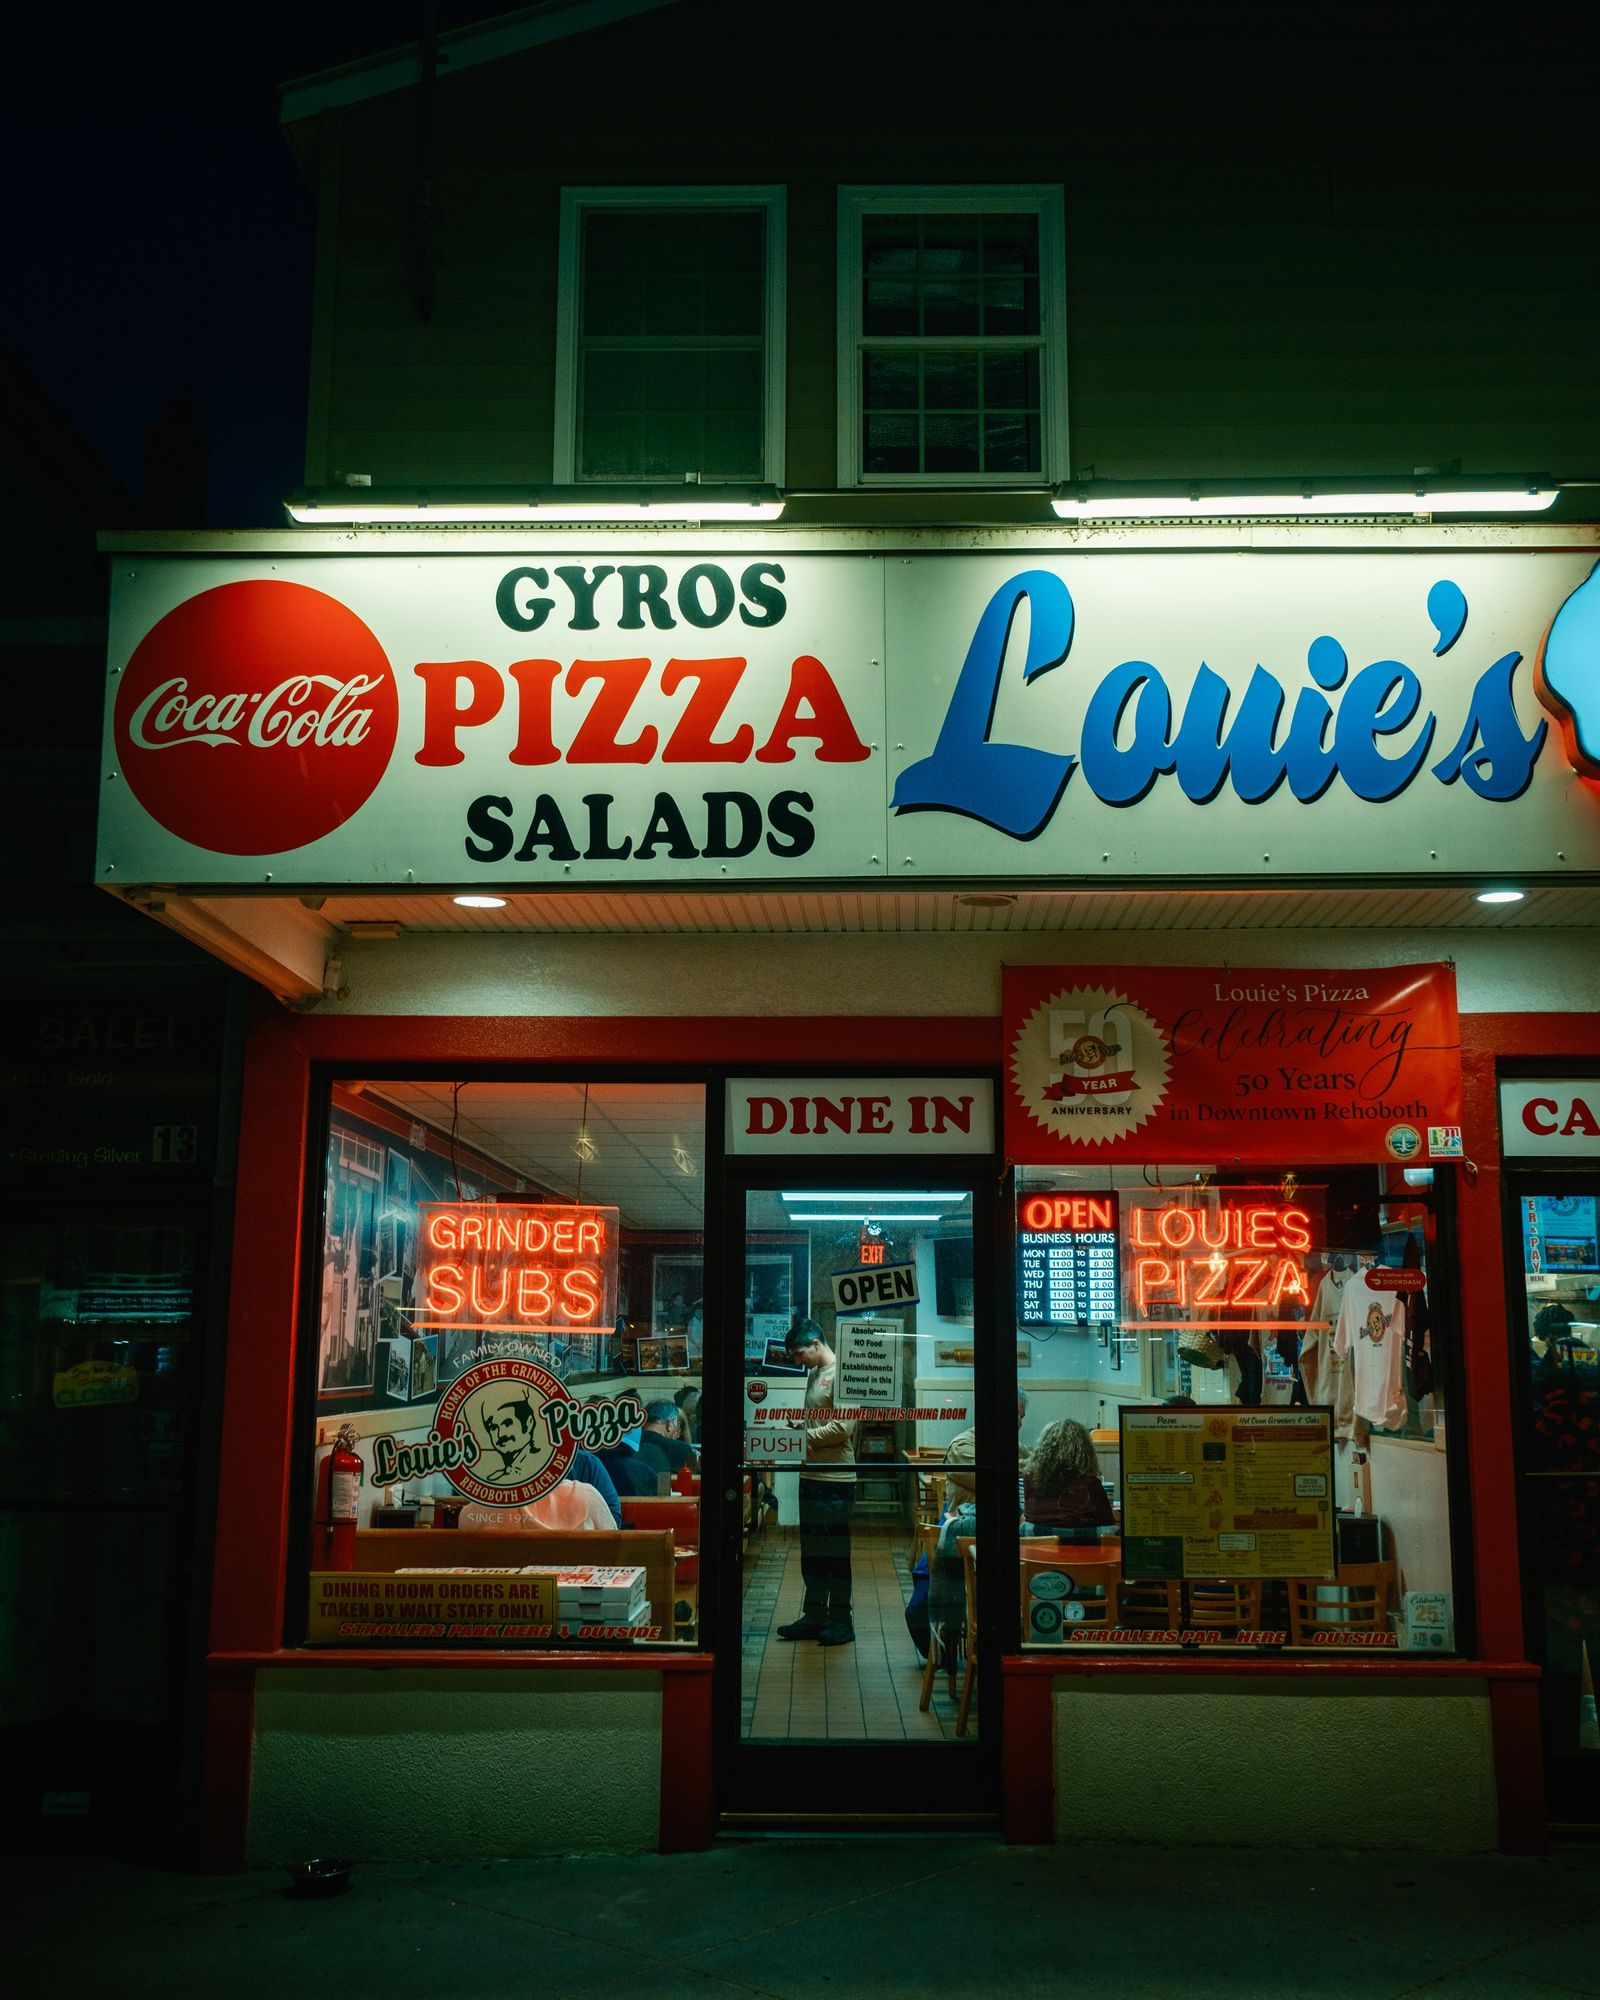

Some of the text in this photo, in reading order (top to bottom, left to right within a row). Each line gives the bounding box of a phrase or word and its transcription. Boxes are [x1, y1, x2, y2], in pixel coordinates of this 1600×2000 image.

[496, 564, 787, 632] GYROS
[129, 674, 384, 750] Coca-Cola
[414, 655, 871, 766] PIZZA
[889, 570, 1547, 842] Louie's
[465, 790, 815, 862] SALADS
[1214, 983, 1369, 1002] Louie's Pizza
[1103, 1003, 1461, 1100] Celebrating
[1081, 1078, 1118, 1090] YEAR
[1235, 1068, 1356, 1098] 50 Years
[745, 1096, 975, 1134] DINE IN
[1051, 1106, 1132, 1115] ANNIVERSARY
[1170, 1101, 1428, 1121] in Downtown Rehoboth
[158, 1127, 194, 1161] 13
[1026, 1199, 1111, 1229] OPEN
[430, 1215, 600, 1254] GRINDER
[1136, 1208, 1310, 1249] LOUIES
[1022, 1233, 1115, 1244] BUSINESS HOURS
[860, 1244, 884, 1264] EXIT
[1023, 1249, 1045, 1258] MON
[1024, 1260, 1040, 1268] TUE
[1024, 1270, 1045, 1278] WED
[1136, 1259, 1309, 1306] PIZZA
[426, 1265, 599, 1318] SUBS
[838, 1269, 915, 1306] OPEN
[1024, 1291, 1037, 1299] FRI
[1024, 1301, 1040, 1309] SAT
[1077, 1301, 1087, 1309] TO
[1024, 1311, 1043, 1319] SUN
[851, 1326, 887, 1336] Absolutely
[854, 1339, 883, 1347] NO Food
[452, 1342, 562, 1369] FAMILY OWNED
[849, 1351, 887, 1360] From Other
[842, 1362, 893, 1372] Establishments
[843, 1375, 892, 1384] Allowed in this
[440, 1364, 559, 1421] HOME OF THE GRINDER
[846, 1388, 888, 1397] Dining Room
[540, 1397, 647, 1451] Pizza
[754, 1408, 968, 1421] NO OUTSIDE FOOD ALLOWED IN THIS DINING ROOM
[750, 1436, 802, 1453] PUSH
[371, 1422, 481, 1487] Louie's
[459, 1453, 569, 1503] REHOBOTH BEACH, DE
[467, 1513, 536, 1524] SINCE 197
[322, 1582, 540, 1599] DINING ROOM ORDERS ARE
[319, 1602, 545, 1619] TAKEN BY WAIT STAFF ONLY!
[339, 1623, 662, 1640] STROLLERS PARK HERE OUTSIDE
[1072, 1629, 1180, 1643] STROLLERS
[1236, 1631, 1287, 1645] HERE
[1312, 1631, 1397, 1645] OUTSIDE
